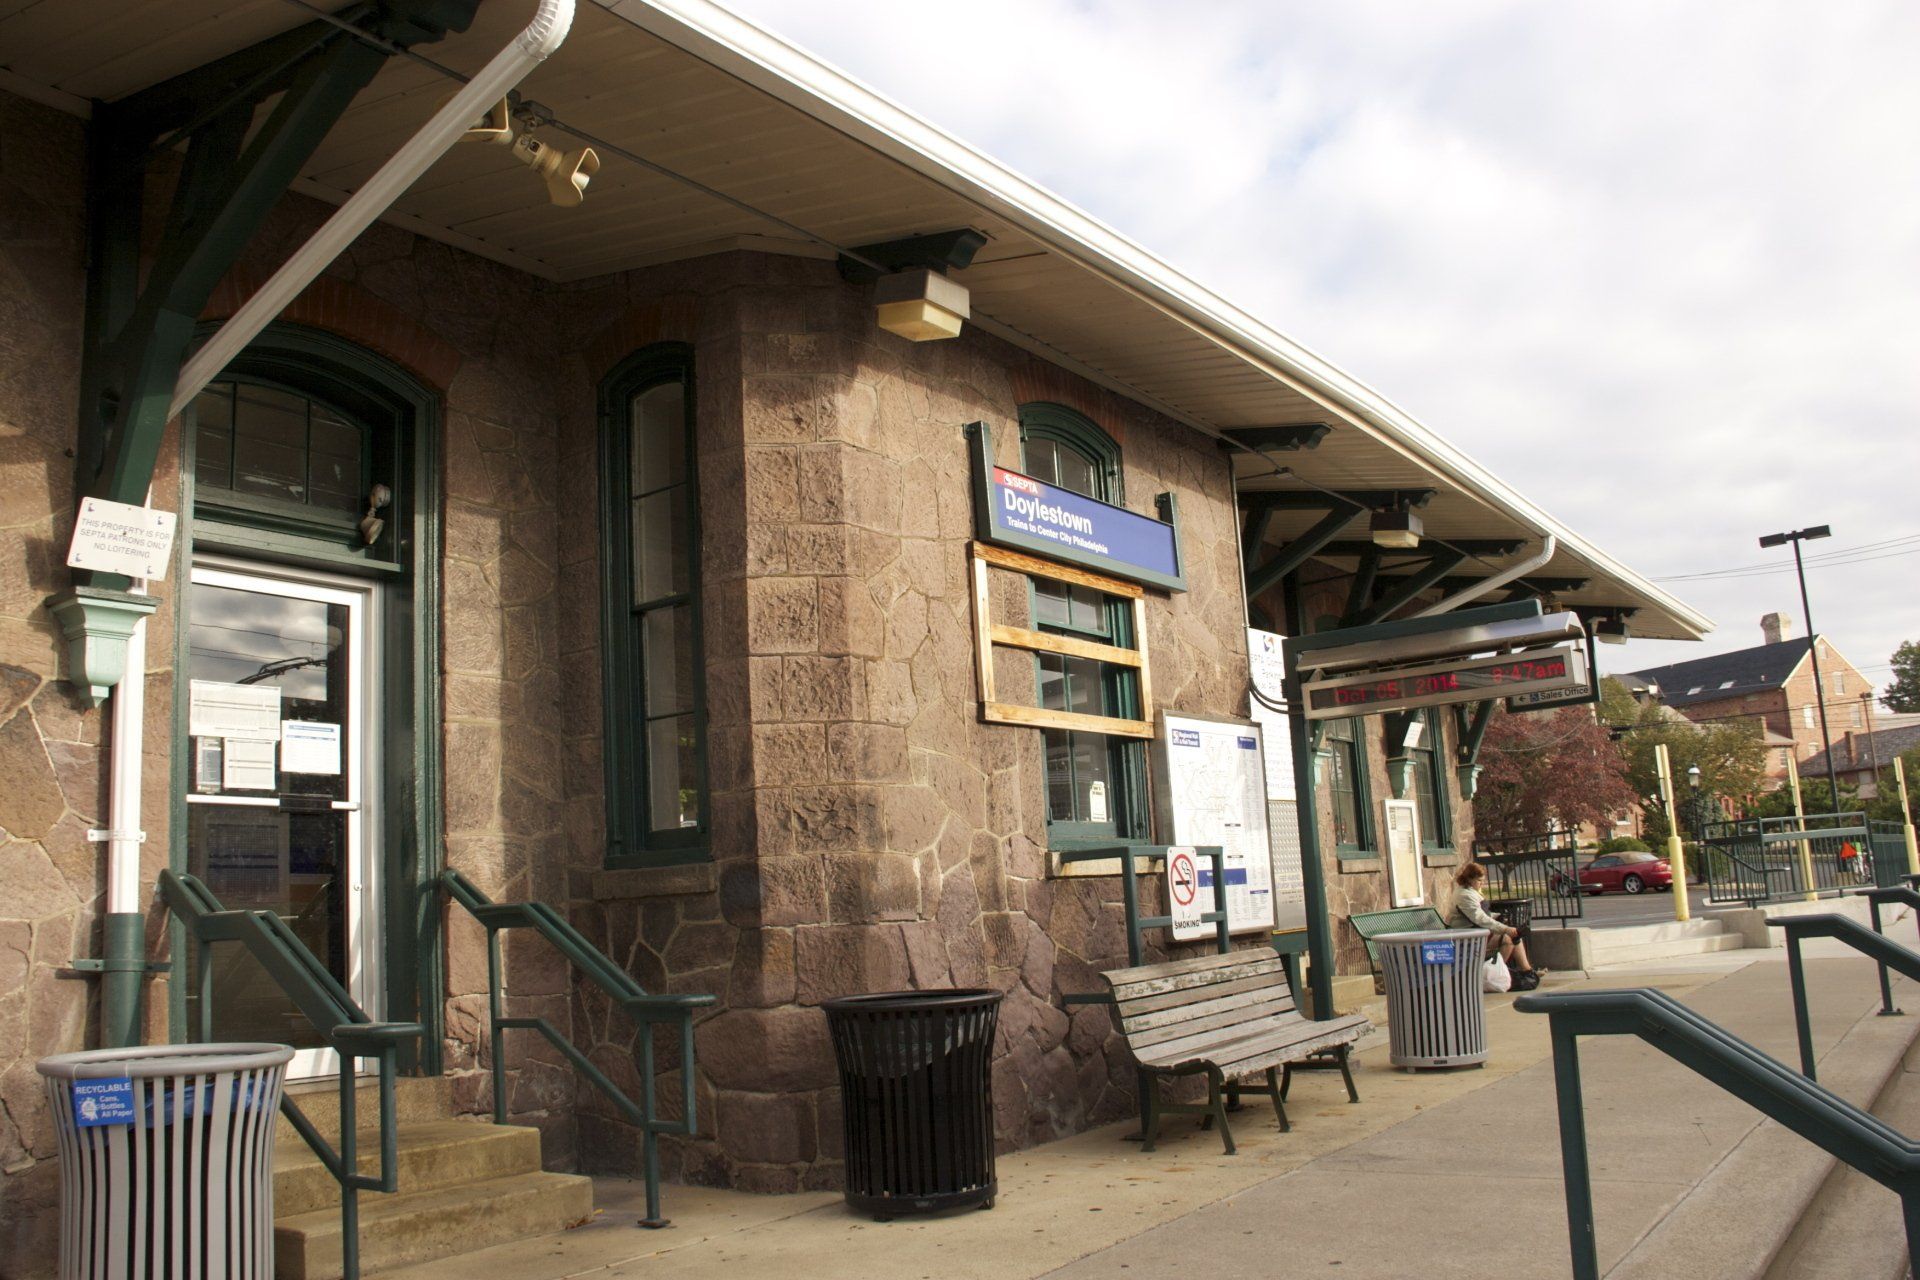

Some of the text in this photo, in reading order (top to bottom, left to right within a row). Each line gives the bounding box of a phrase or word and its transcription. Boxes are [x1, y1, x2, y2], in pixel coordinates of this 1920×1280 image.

[1013, 477, 1039, 494] SEPTA
[1004, 488, 1093, 535] Doylestown
[80, 528, 167, 549] SEPTA PATRONS ONLY
[82, 518, 100, 527] THIS
[101, 521, 146, 535] PROPERTY
[155, 531, 170, 540] FOR
[1007, 515, 1109, 554] Trains to Center City Philadelphia
[94, 542, 151, 558] NO LOITERING
[1416, 673, 1459, 696] 2014
[1539, 686, 1589, 700] Sales Office
[1174, 920, 1200, 930] SMOKING
[75, 1082, 131, 1094] RECYCLABLE
